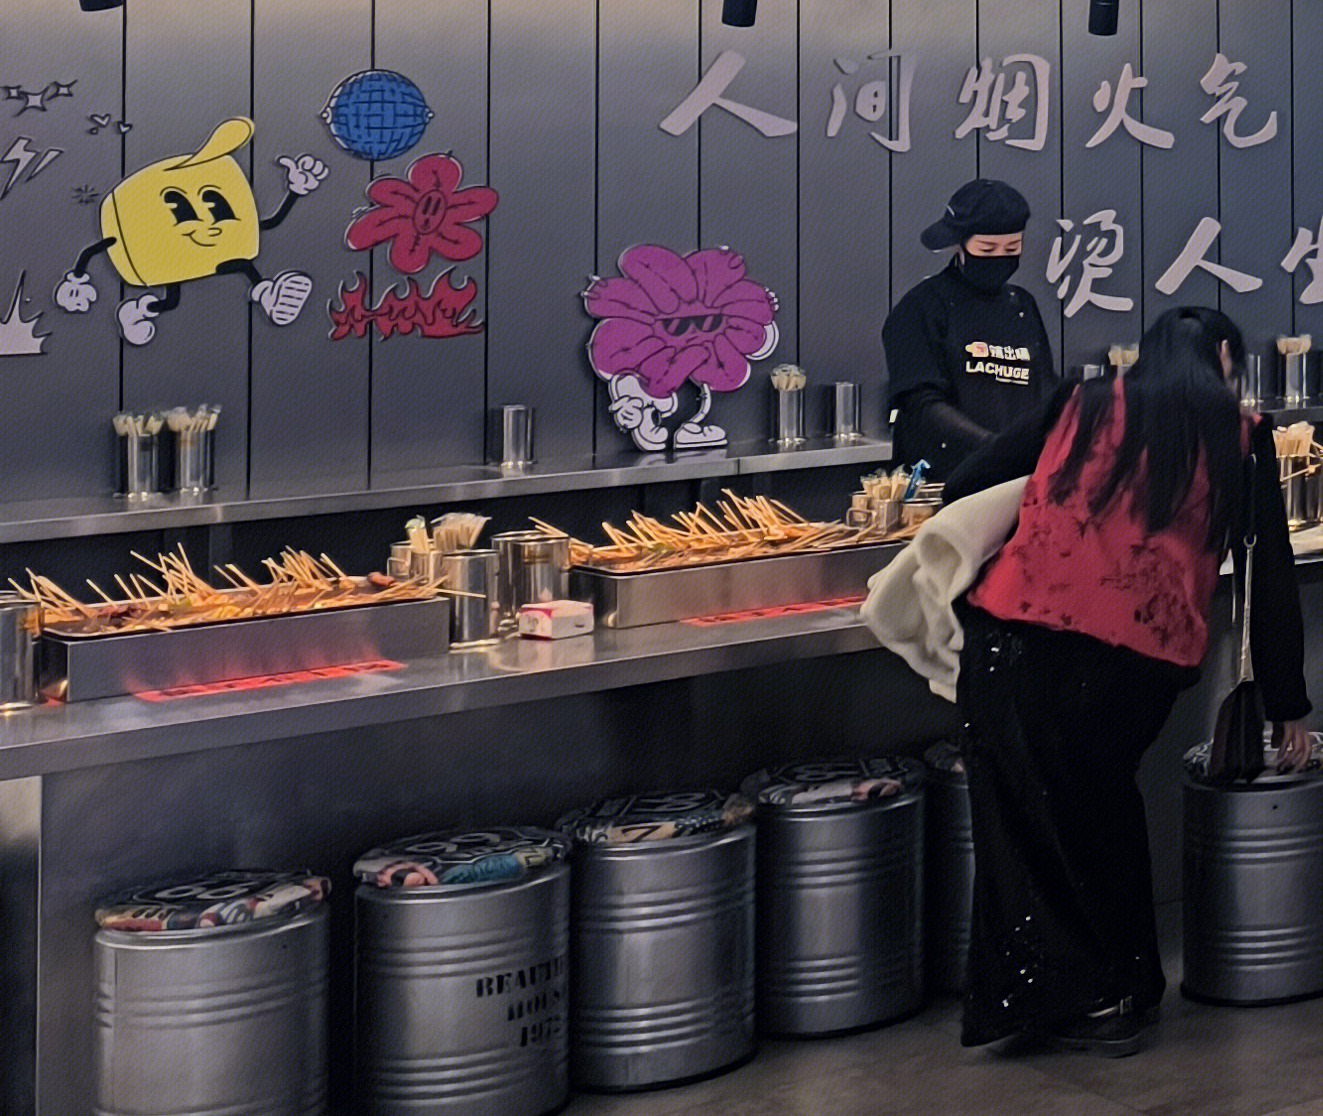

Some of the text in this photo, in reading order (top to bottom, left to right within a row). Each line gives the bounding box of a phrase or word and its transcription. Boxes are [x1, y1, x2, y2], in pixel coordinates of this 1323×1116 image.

[660, 47, 1279, 153] 人间烟火气
[965, 361, 1030, 381] LACHUGE
